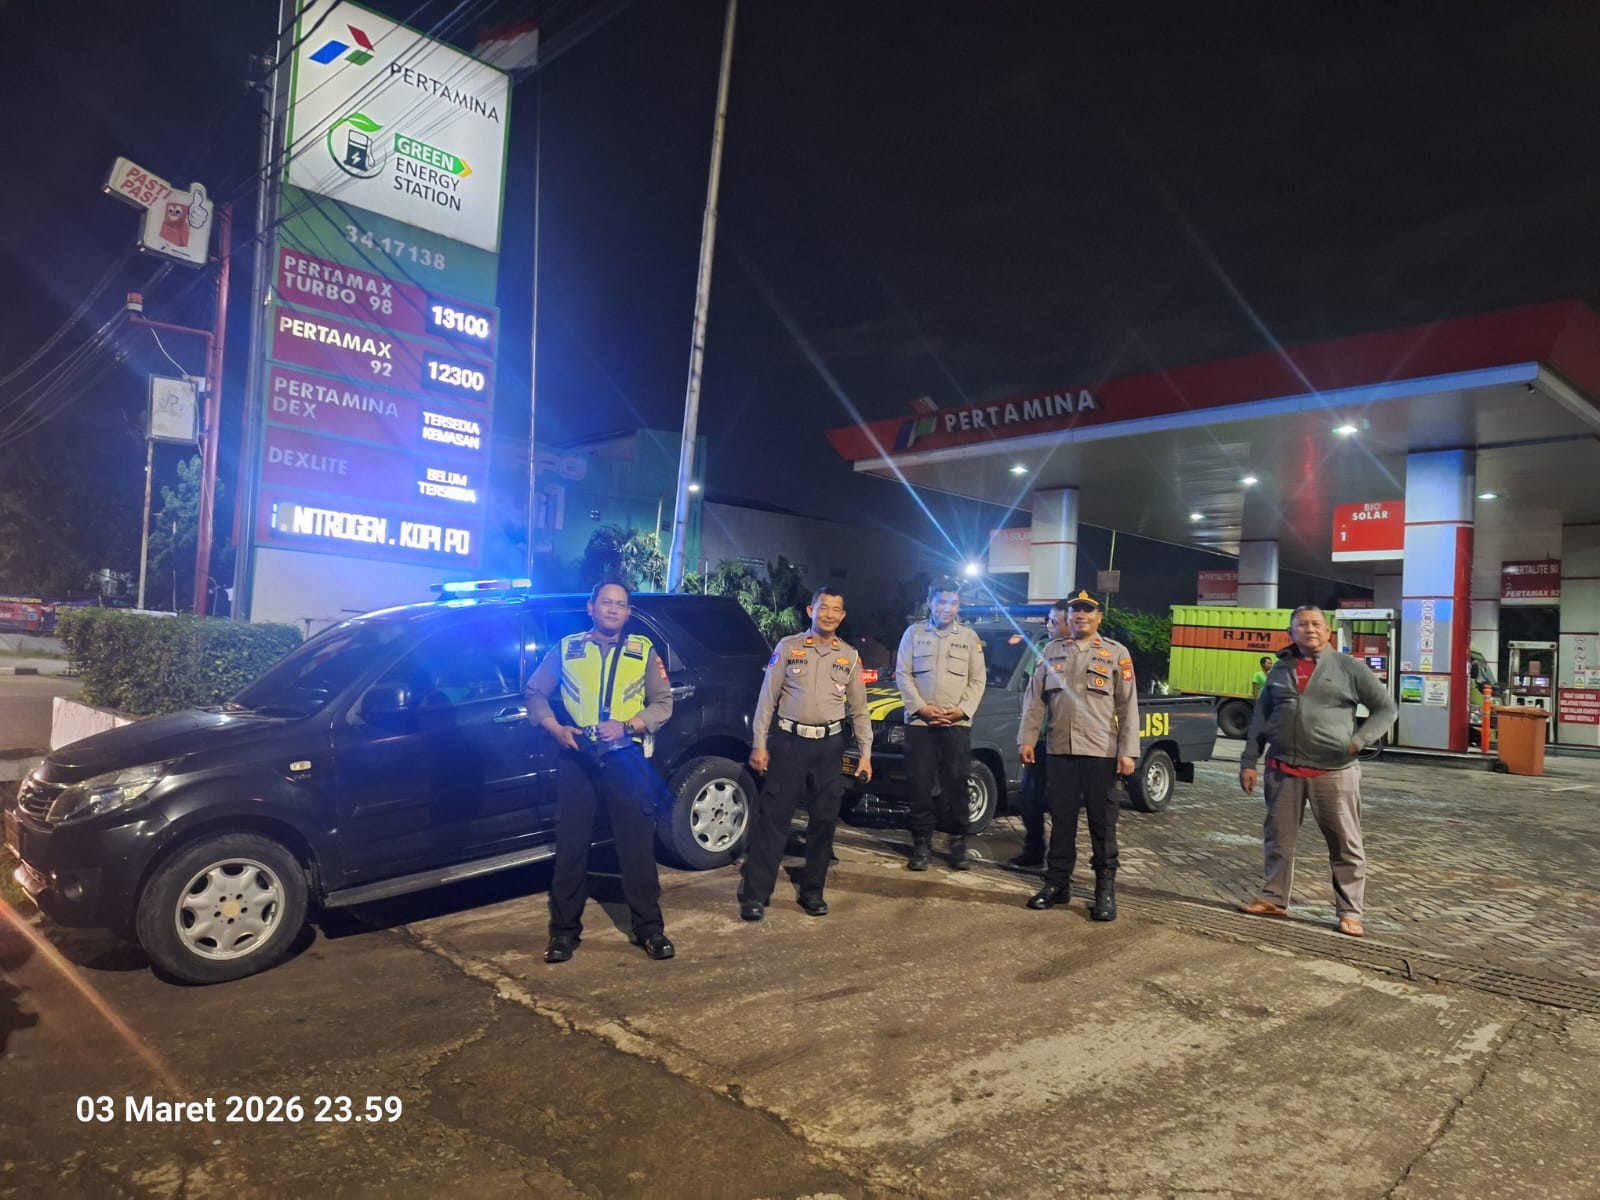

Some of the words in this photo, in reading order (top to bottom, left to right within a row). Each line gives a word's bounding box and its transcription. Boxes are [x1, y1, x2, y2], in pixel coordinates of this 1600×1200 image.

[390, 63, 499, 124] PERTAMINA
[397, 138, 455, 172] GREEN
[126, 167, 173, 200] PASTI
[396, 158, 460, 192] ENERGY
[120, 180, 158, 206] PAS!
[394, 175, 462, 212] STATION
[345, 224, 446, 271] 34.17138
[284, 255, 393, 298] PERTAMAX
[283, 272, 356, 304] TURBO
[369, 296, 393, 315] 98
[279, 316, 392, 359] PERTAMAX
[431, 305, 490, 339] 13100
[370, 360, 392, 377] 92
[428, 361, 485, 391] 12300
[272, 396, 317, 419] DEX
[275, 376, 399, 417] PERTAMINA
[944, 389, 1096, 433] PERTAMINA
[422, 411, 480, 435] TERSEDIA
[268, 446, 348, 475] DEXLITE
[1351, 510, 1389, 521] SOLAR
[1363, 503, 1381, 511] BIO
[1340, 531, 1347, 542] 1
[1223, 630, 1271, 642] RJTM
